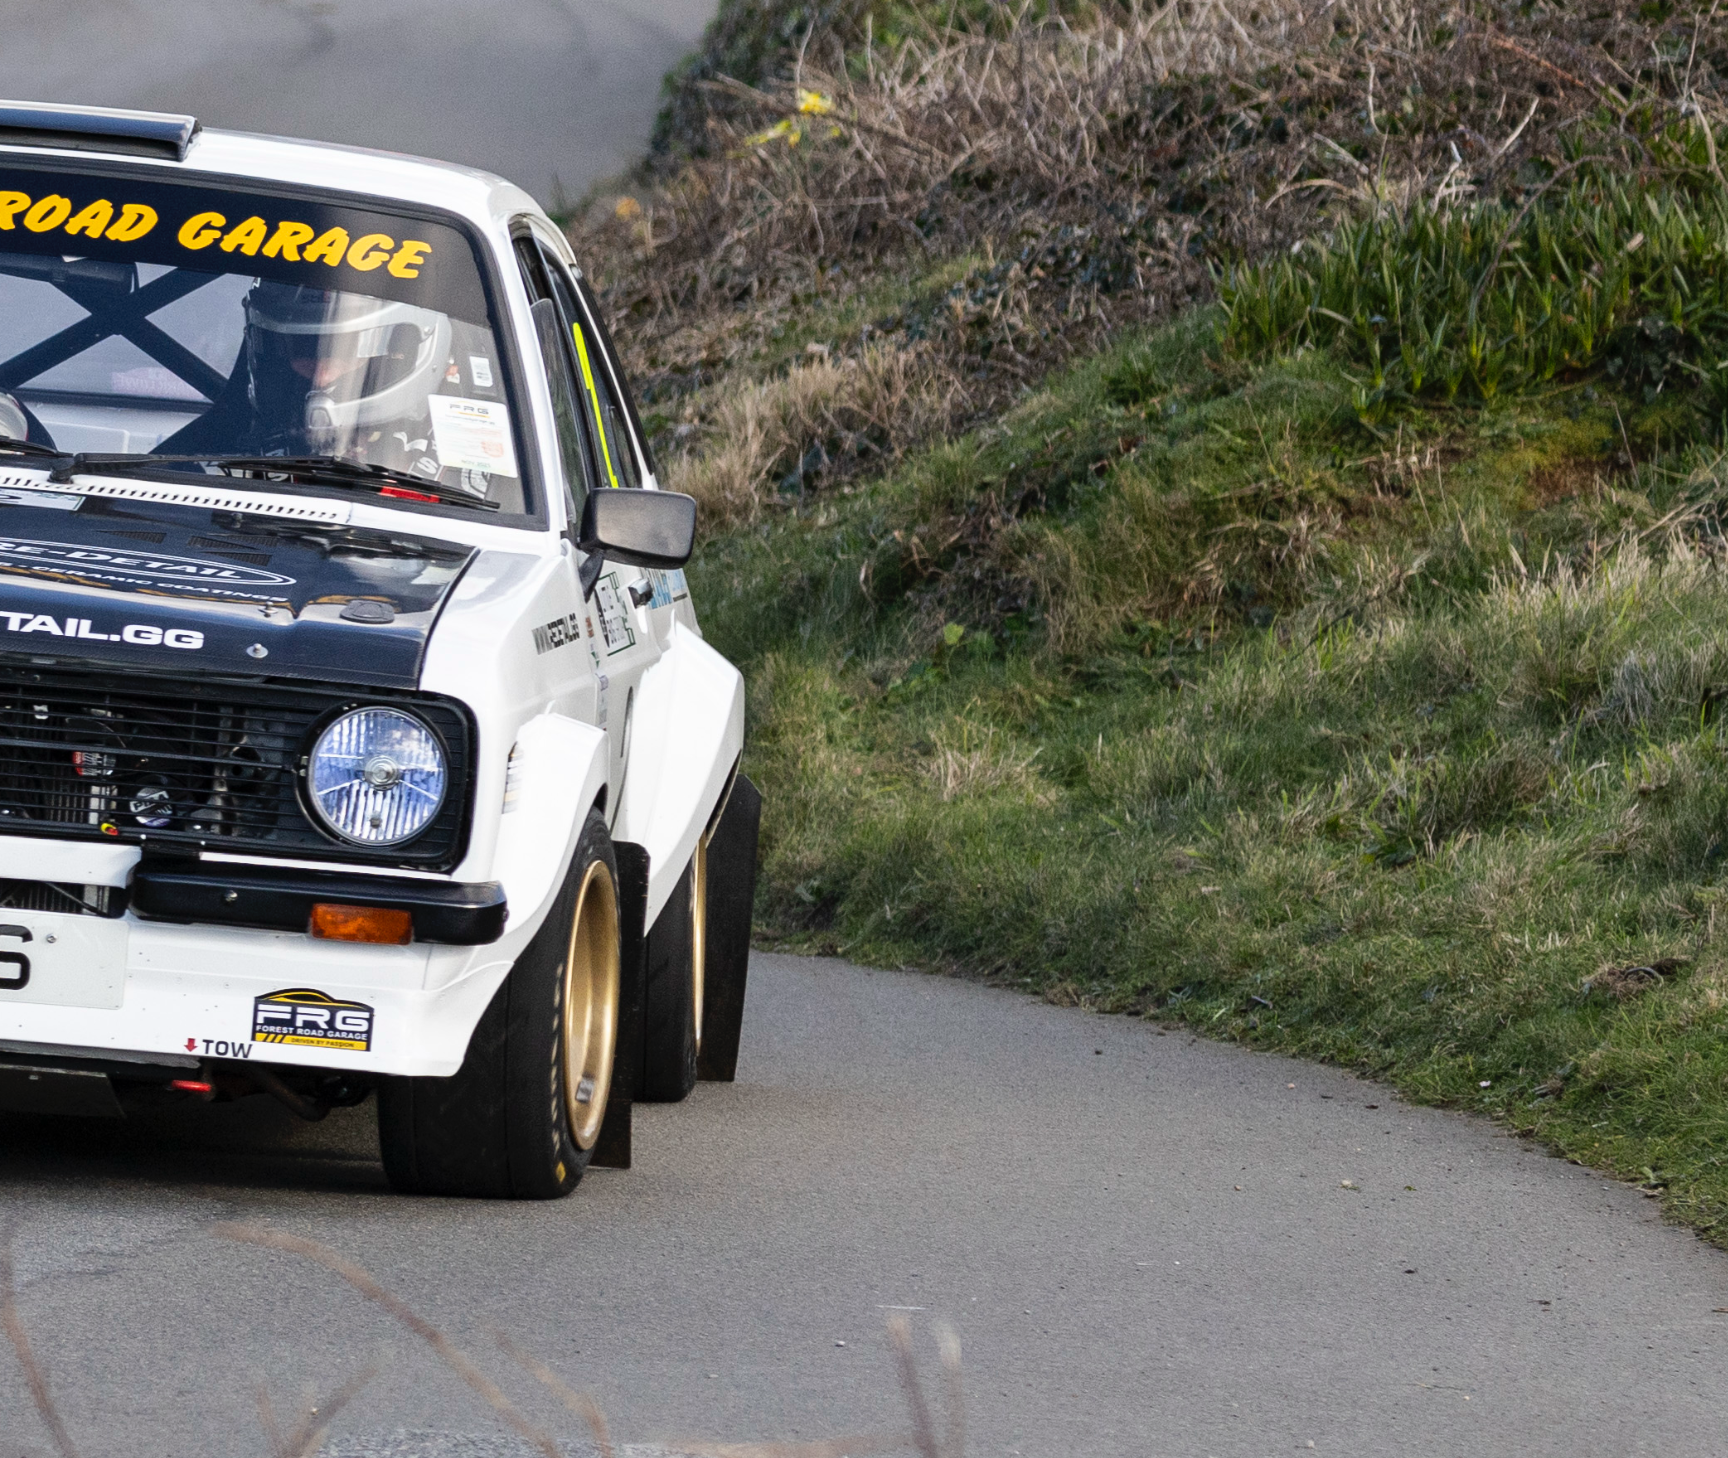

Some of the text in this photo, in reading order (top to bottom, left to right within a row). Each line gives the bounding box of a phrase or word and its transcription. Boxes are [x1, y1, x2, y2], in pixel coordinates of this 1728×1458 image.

[177, 211, 433, 279] GARAGE
[32, 565, 151, 585] CERAMIC
[160, 582, 289, 603] COATINGS
[256, 1003, 370, 1032] FRG
[256, 1025, 368, 1040] FOREST ROAD GARAGE
[325, 1040, 355, 1048] PASSION
[202, 1039, 253, 1058] TOW
